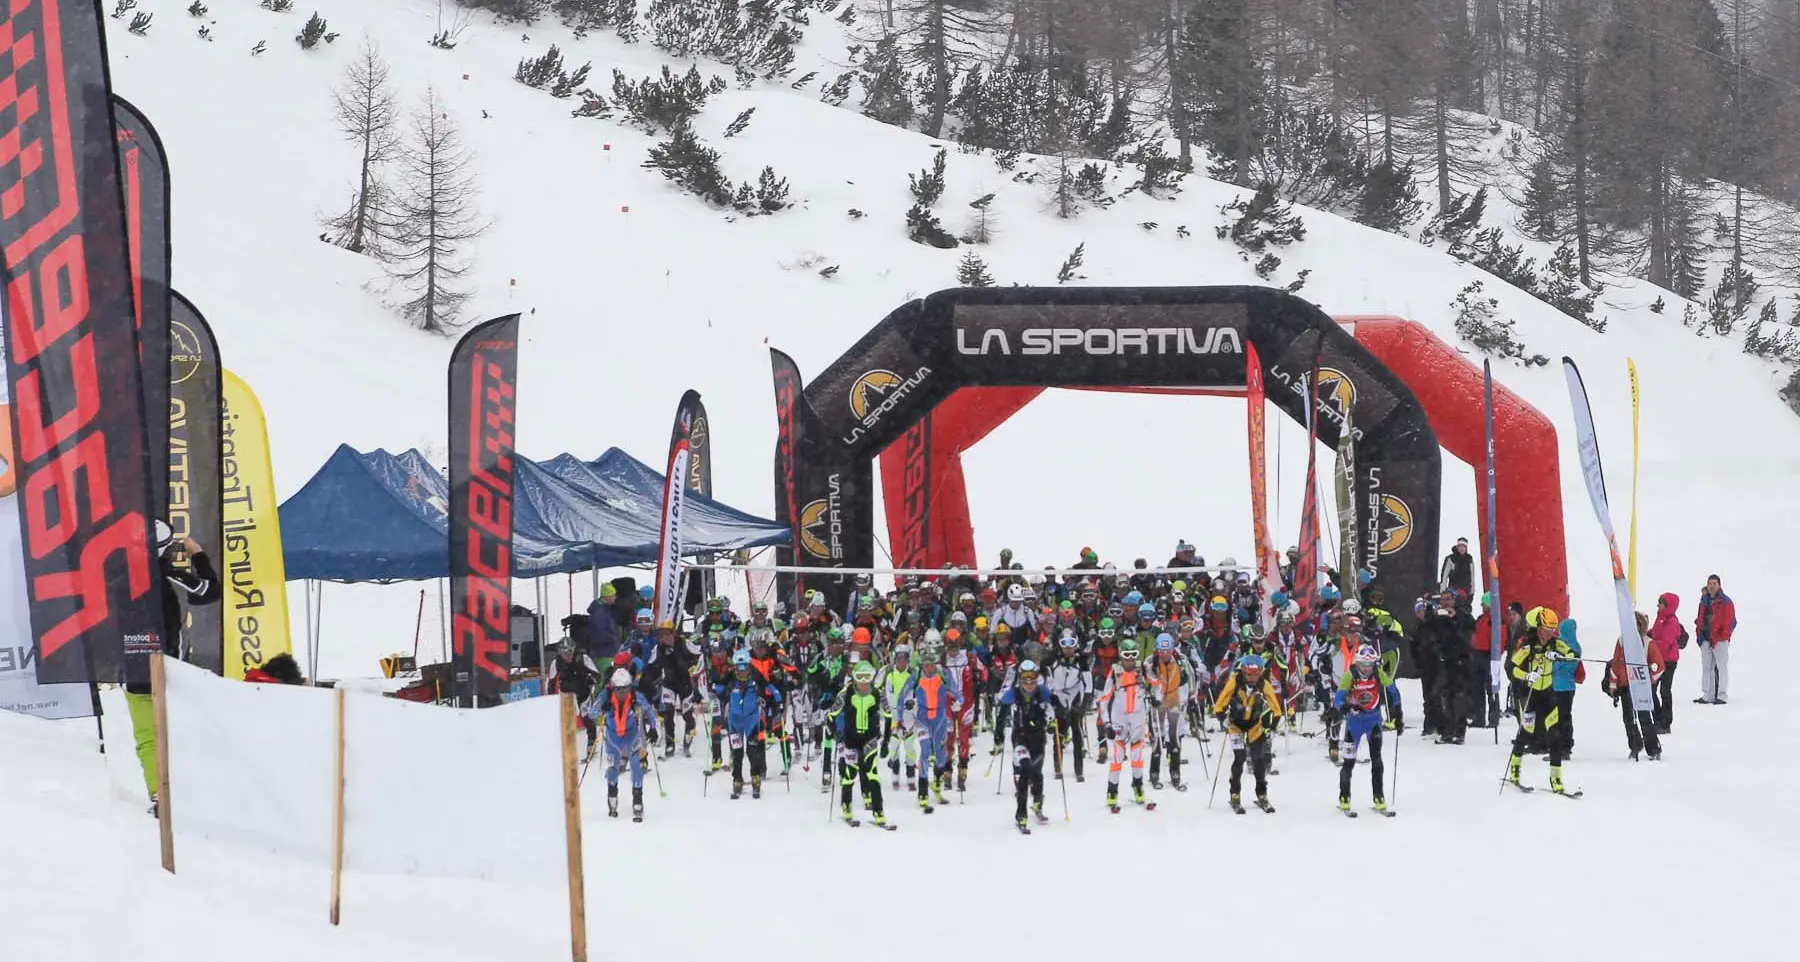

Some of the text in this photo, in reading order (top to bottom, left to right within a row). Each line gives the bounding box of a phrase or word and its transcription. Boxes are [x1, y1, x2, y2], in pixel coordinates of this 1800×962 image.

[957, 328, 1011, 355] LA
[1270, 365, 1291, 385] LA
[843, 366, 932, 444] LA SPORTIVA
[1369, 467, 1381, 489] LA
[828, 473, 843, 558] SPORTIVA
